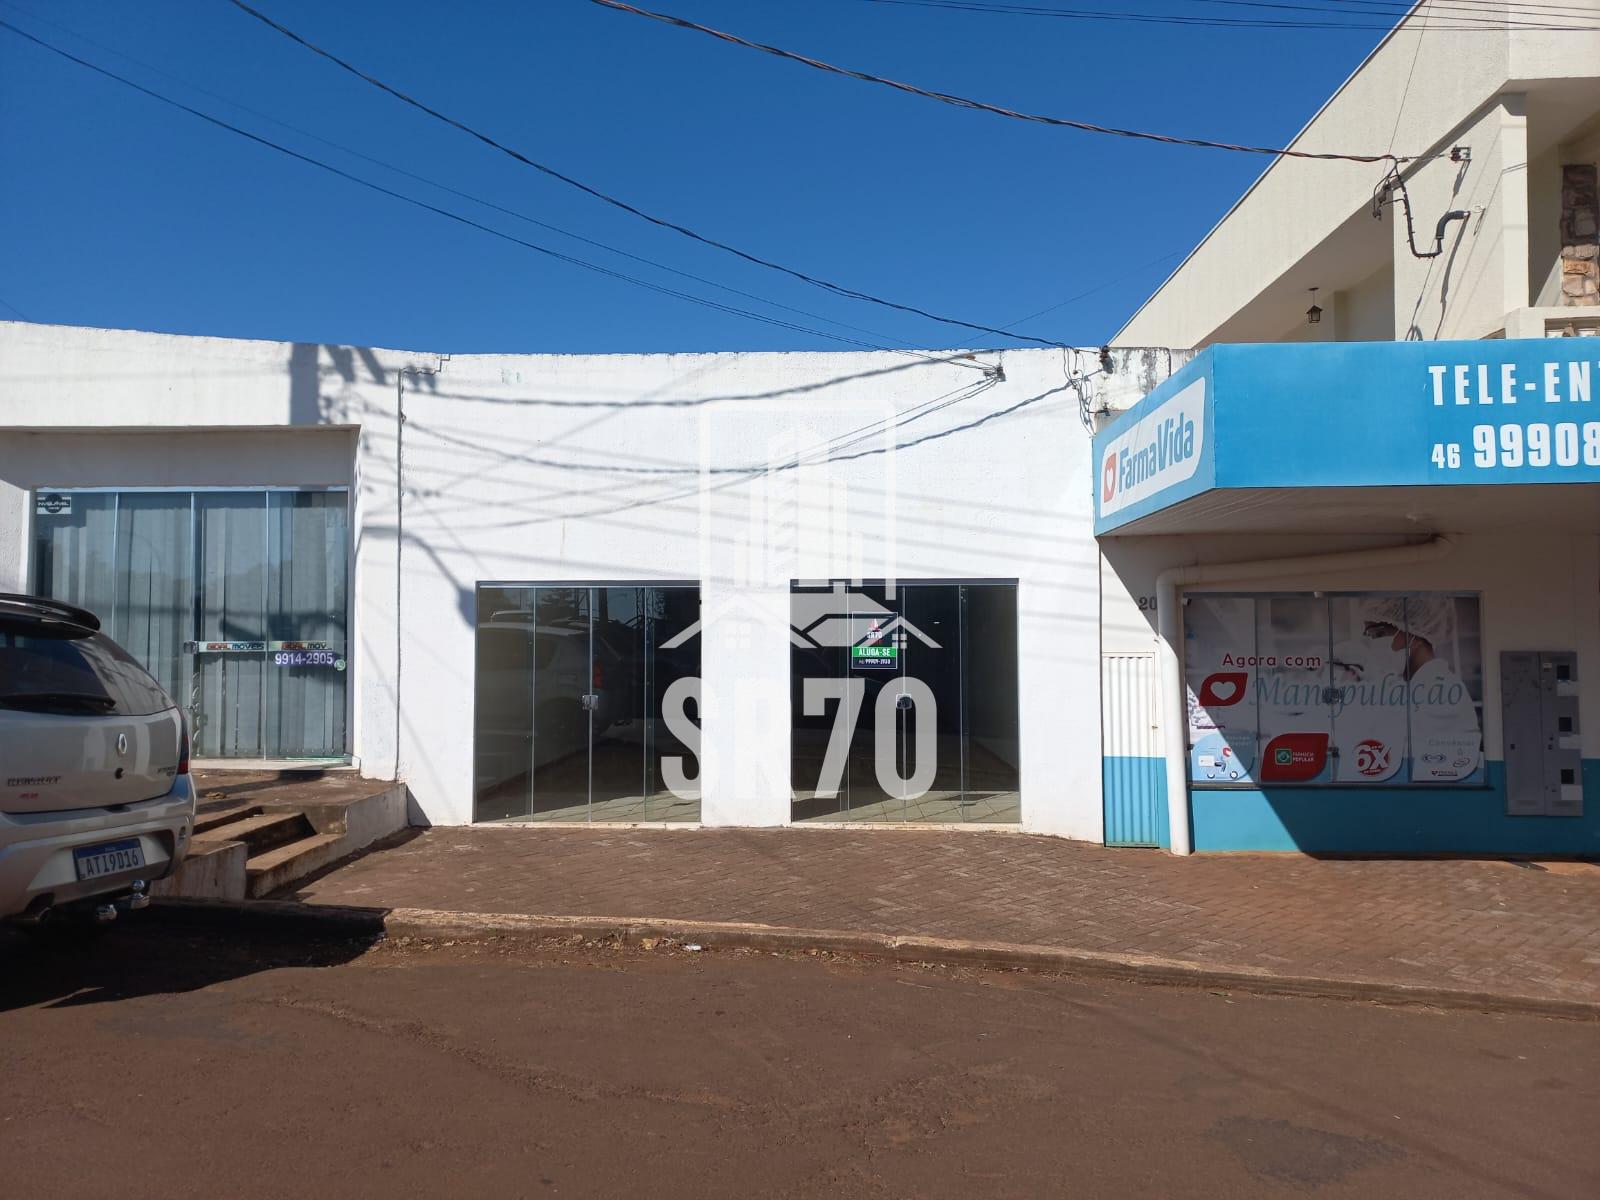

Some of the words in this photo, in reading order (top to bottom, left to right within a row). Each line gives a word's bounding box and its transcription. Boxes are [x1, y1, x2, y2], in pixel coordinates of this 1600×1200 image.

[1428, 361, 1600, 406] TELE-EN
[1118, 412, 1195, 493] FarmaVida
[1431, 443, 1461, 469] 46
[1473, 422, 1600, 468] 99908
[275, 653, 334, 665] 9914-2905
[858, 648, 891, 656] ALUGA-SE
[1222, 653, 1277, 668] Agora
[1285, 656, 1321, 667] com
